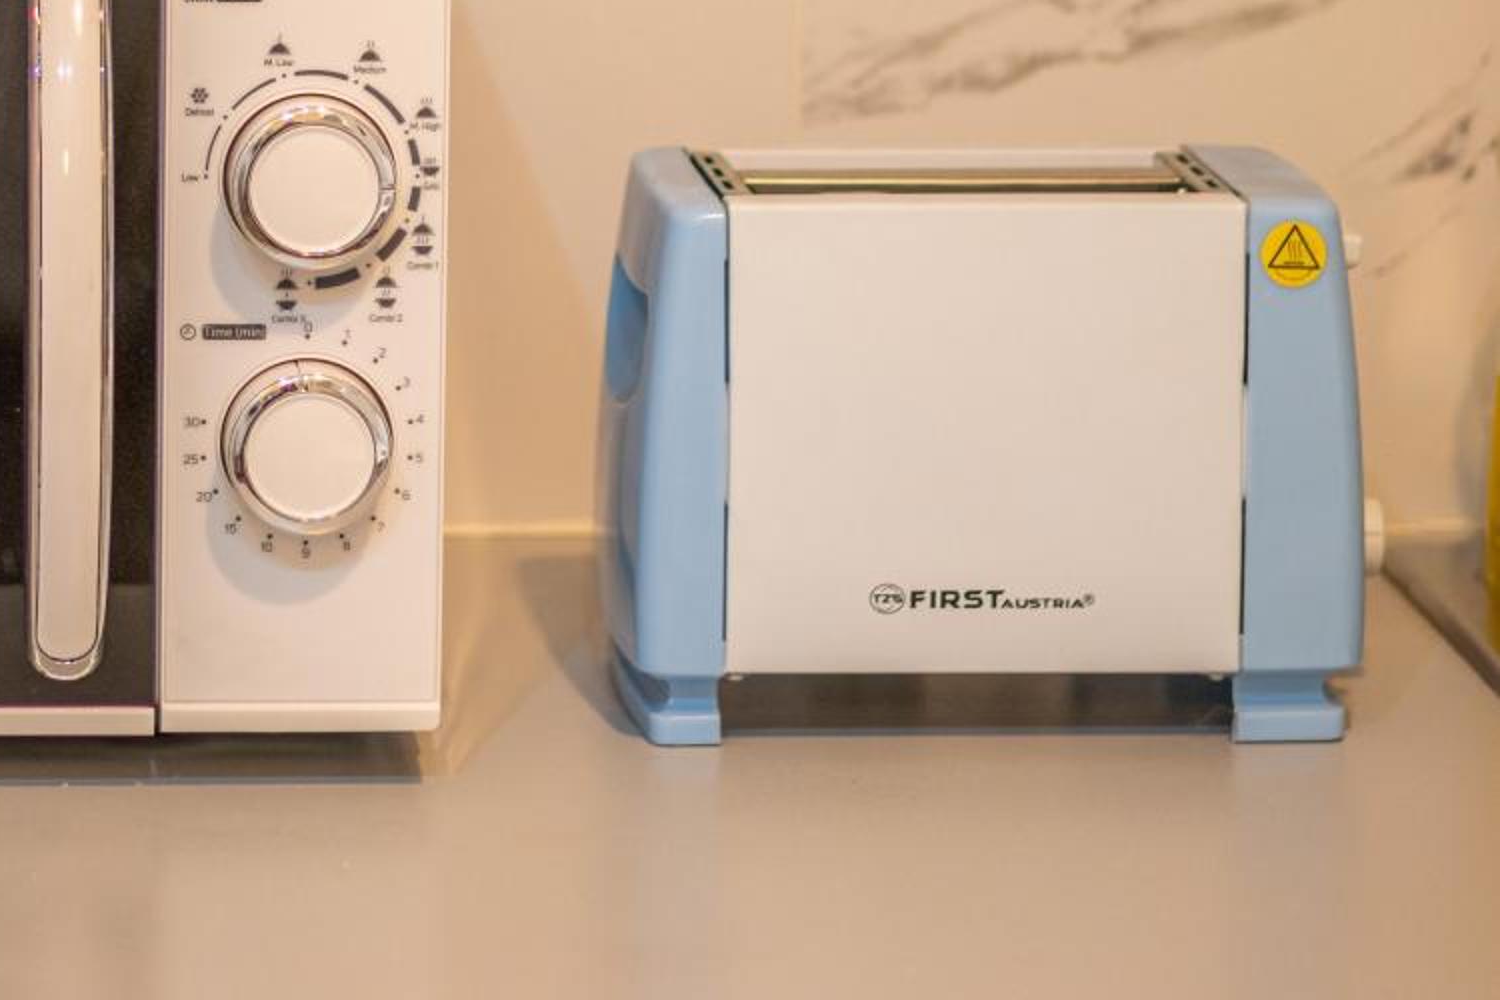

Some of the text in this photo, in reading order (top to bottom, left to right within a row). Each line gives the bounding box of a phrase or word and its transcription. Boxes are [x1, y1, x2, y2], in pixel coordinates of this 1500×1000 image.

[353, 65, 387, 74] Medium
[185, 107, 214, 117] Defrost
[181, 172, 199, 183] Low
[183, 454, 199, 465] 25
[195, 491, 213, 503] 20
[260, 540, 273, 552] 10
